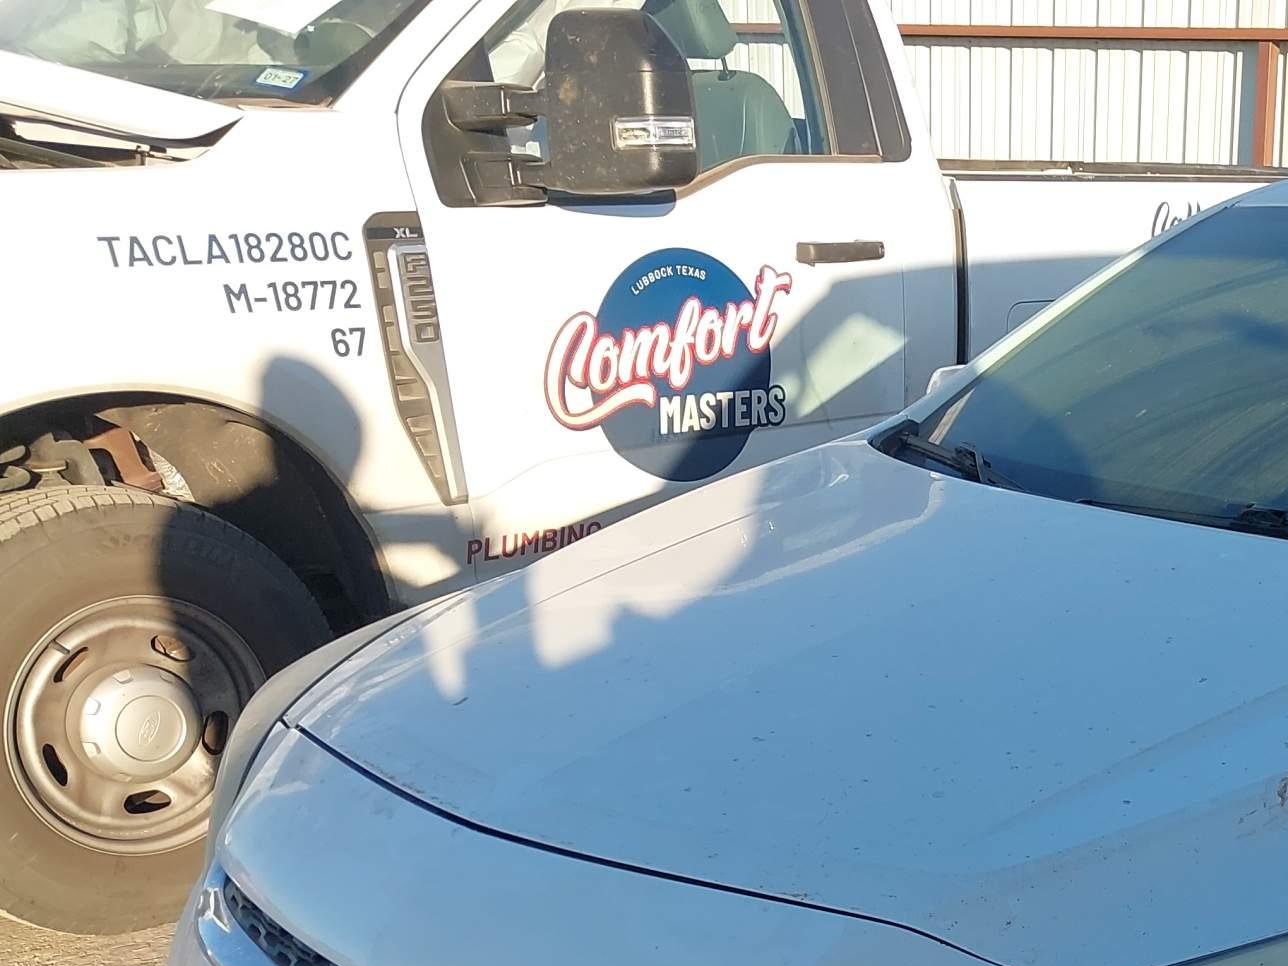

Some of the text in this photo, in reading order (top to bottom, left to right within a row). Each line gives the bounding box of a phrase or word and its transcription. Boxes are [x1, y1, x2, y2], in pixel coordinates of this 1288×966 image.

[96, 231, 353, 268] TACLA18280C
[393, 227, 418, 239] XL
[223, 279, 362, 314] M-18772
[631, 264, 707, 295] LUBBOCK TEXAS
[330, 327, 367, 358] 67
[543, 264, 793, 432] Comfort
[658, 384, 787, 436] MASTERS
